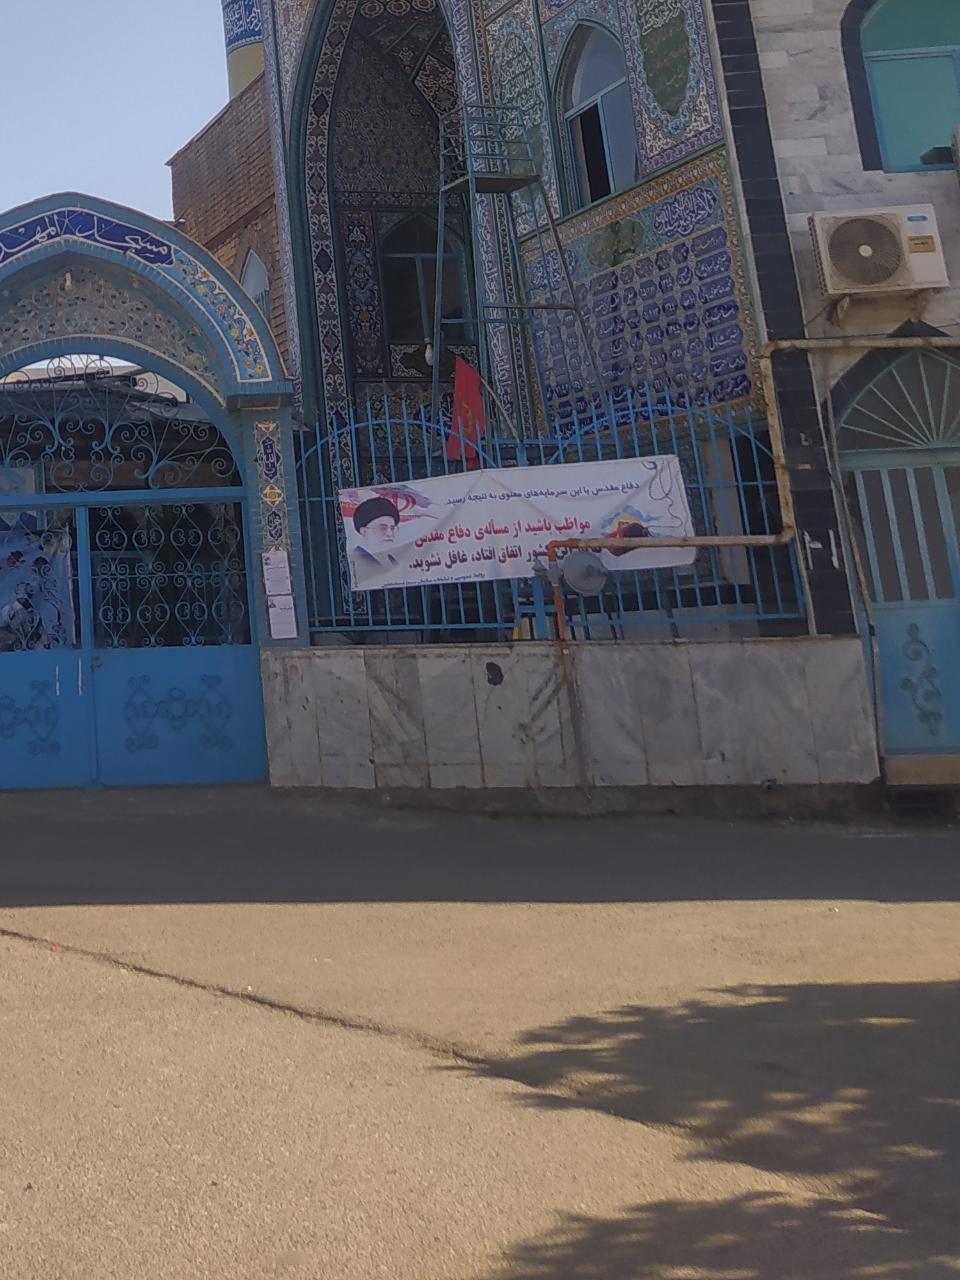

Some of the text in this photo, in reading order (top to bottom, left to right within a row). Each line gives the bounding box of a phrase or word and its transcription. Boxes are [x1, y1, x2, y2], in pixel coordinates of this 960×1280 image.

[75, 215, 169, 258] مسجد
[569, 486, 583, 498] این
[592, 484, 620, 496] مقدس
[621, 481, 640, 493] دفاع
[445, 496, 467, 506] رسید
[467, 493, 488, 503] نتیجه
[498, 491, 522, 501] معنوی
[447, 524, 471, 543] دفاع
[512, 521, 522, 538] از
[525, 519, 552, 537] باشید
[554, 517, 591, 535] مواظب
[414, 528, 445, 548] مقدس
[444, 550, 468, 569] غافل
[498, 545, 522, 565] اتفاق
